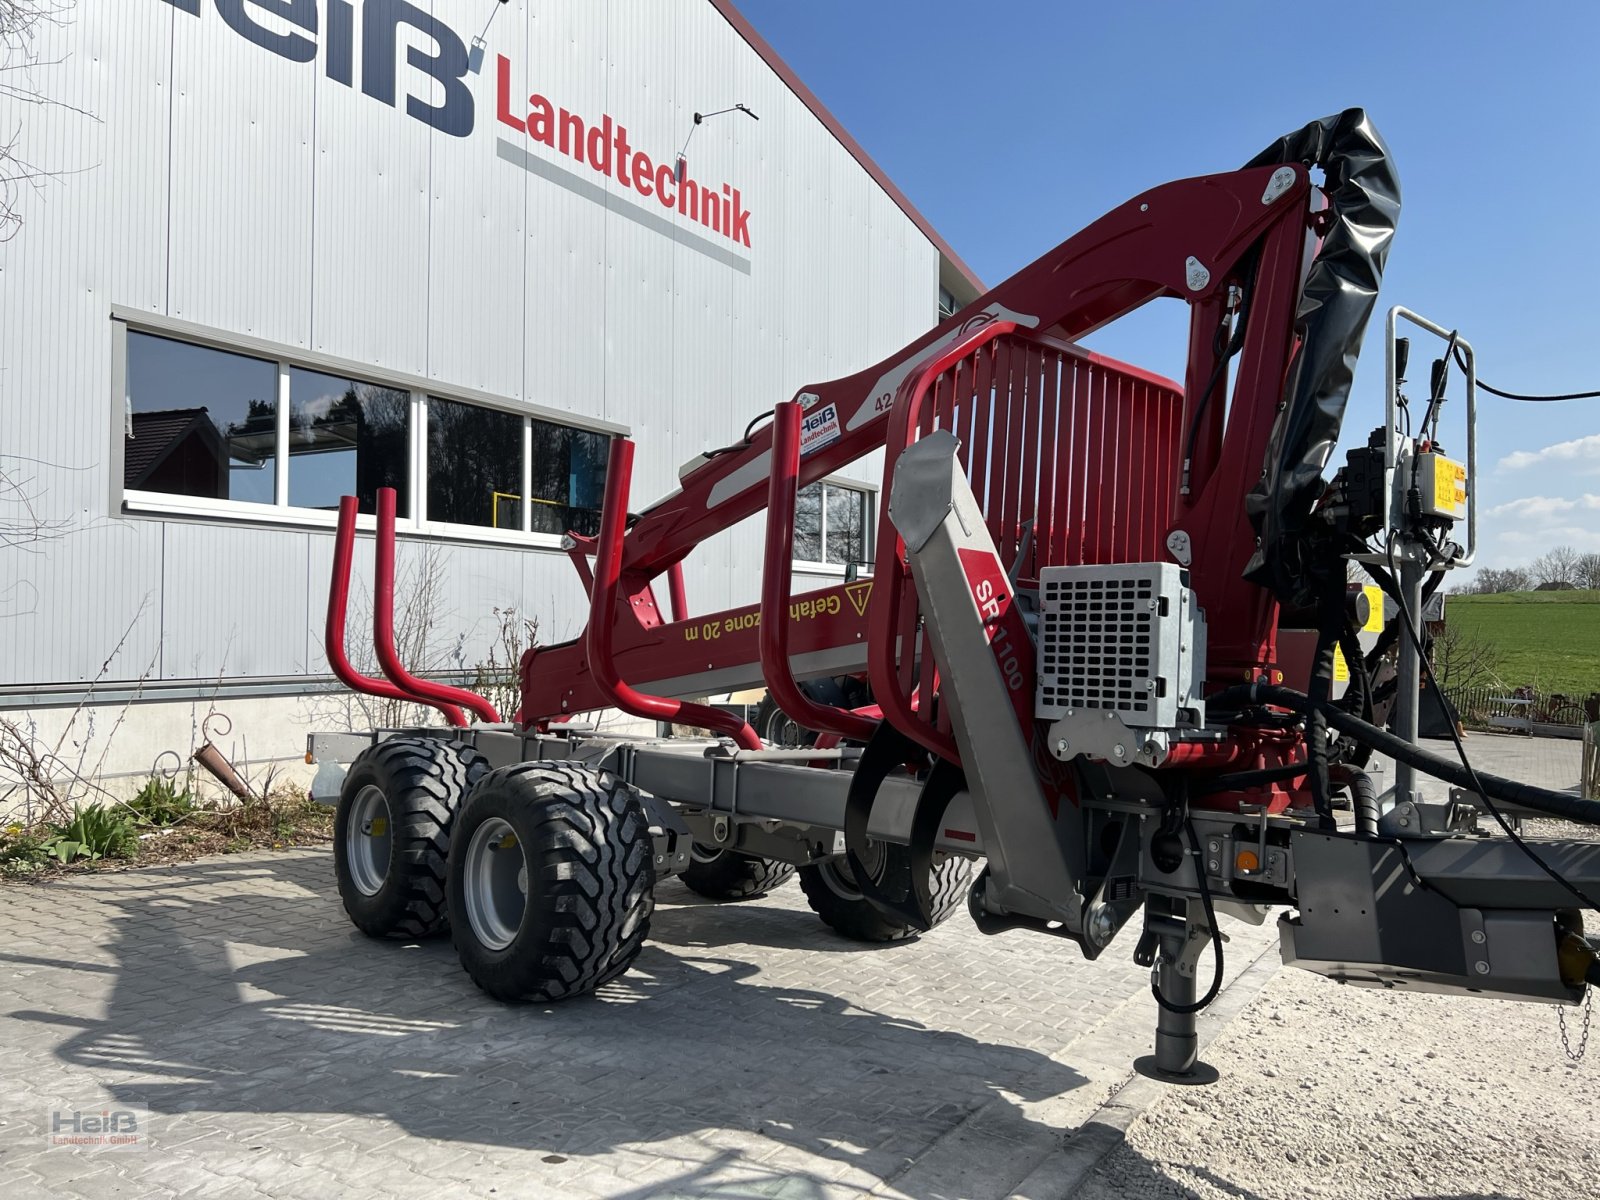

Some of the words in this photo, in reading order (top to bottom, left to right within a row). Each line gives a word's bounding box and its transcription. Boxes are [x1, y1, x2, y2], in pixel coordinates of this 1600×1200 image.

[497, 53, 752, 249] Landtechnik
[684, 626, 699, 641] m
[703, 621, 721, 641] 20
